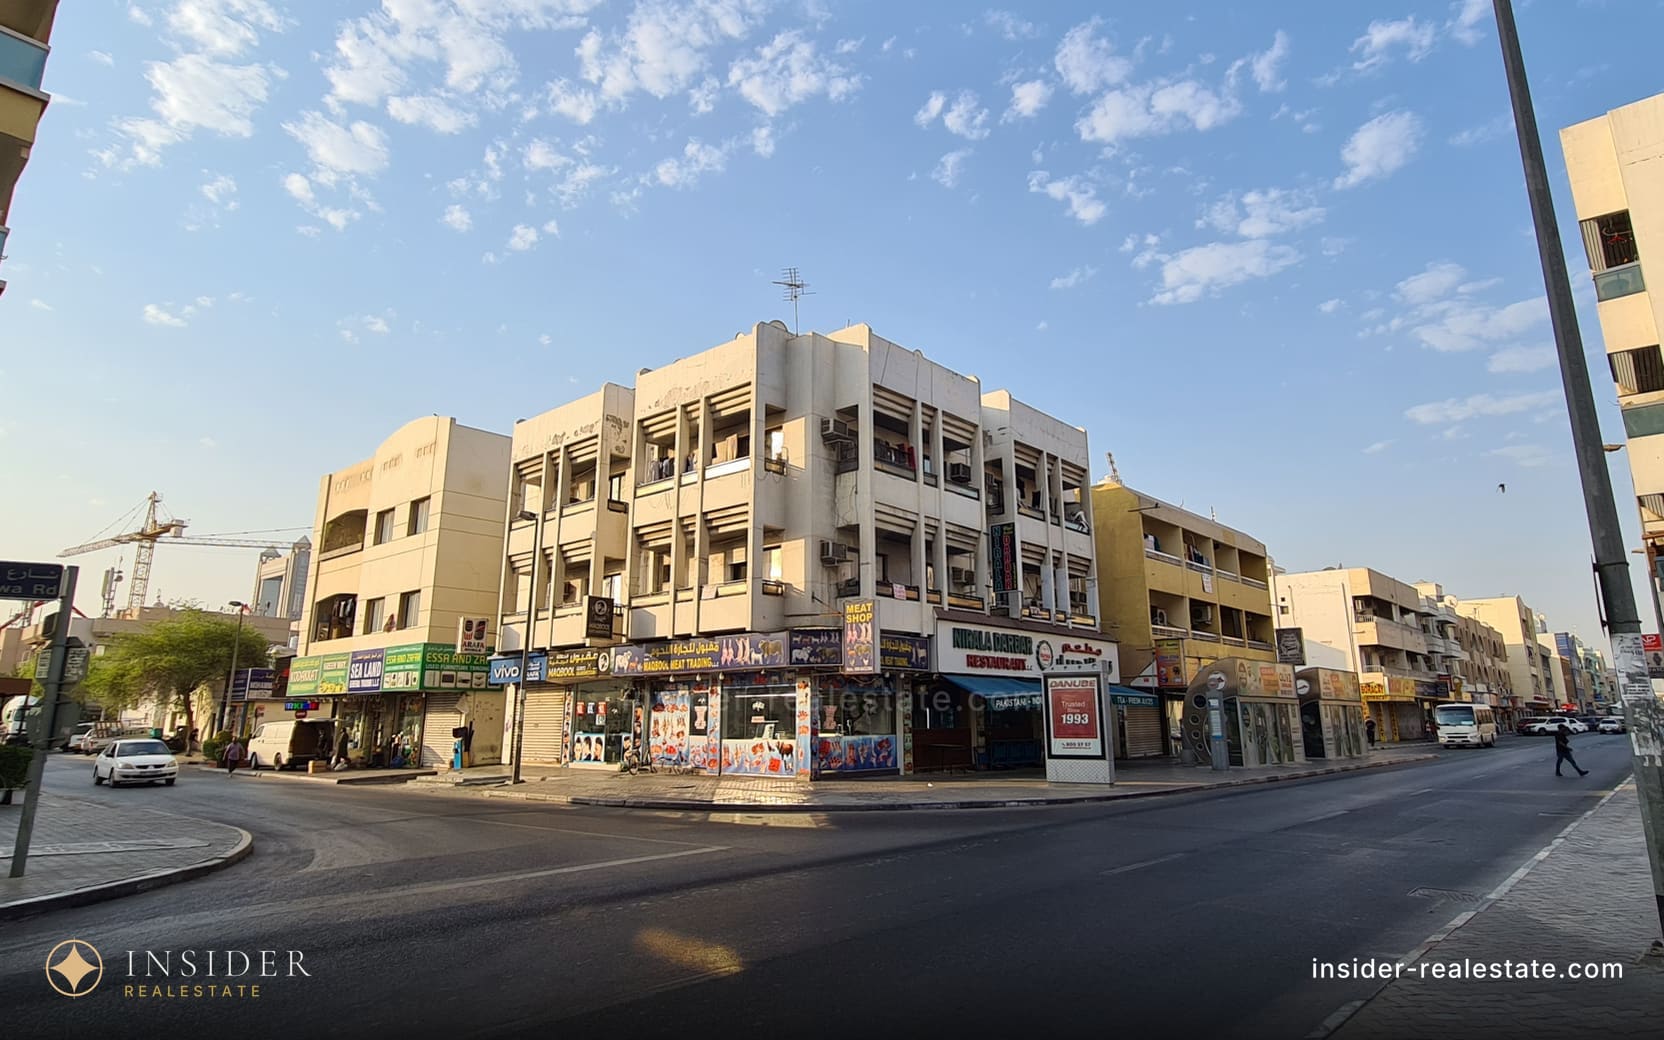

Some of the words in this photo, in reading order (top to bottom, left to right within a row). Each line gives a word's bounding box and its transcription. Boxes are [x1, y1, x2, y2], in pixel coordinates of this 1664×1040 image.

[33, 584, 57, 595] Rd
[846, 602, 873, 613] MEAT
[846, 613, 873, 623] SHOP
[463, 641, 484, 649] ARAFA
[952, 628, 992, 651] NIRALA
[992, 632, 1033, 655] DARBAR
[426, 653, 450, 663] ESSA
[453, 653, 472, 664] AND
[966, 654, 1027, 671] RESTAURANT
[350, 663, 363, 679] SEA
[364, 662, 381, 677] LAND
[494, 664, 519, 678] vivo
[1050, 680, 1096, 688] DANUBE
[1061, 713, 1089, 724] 1993
